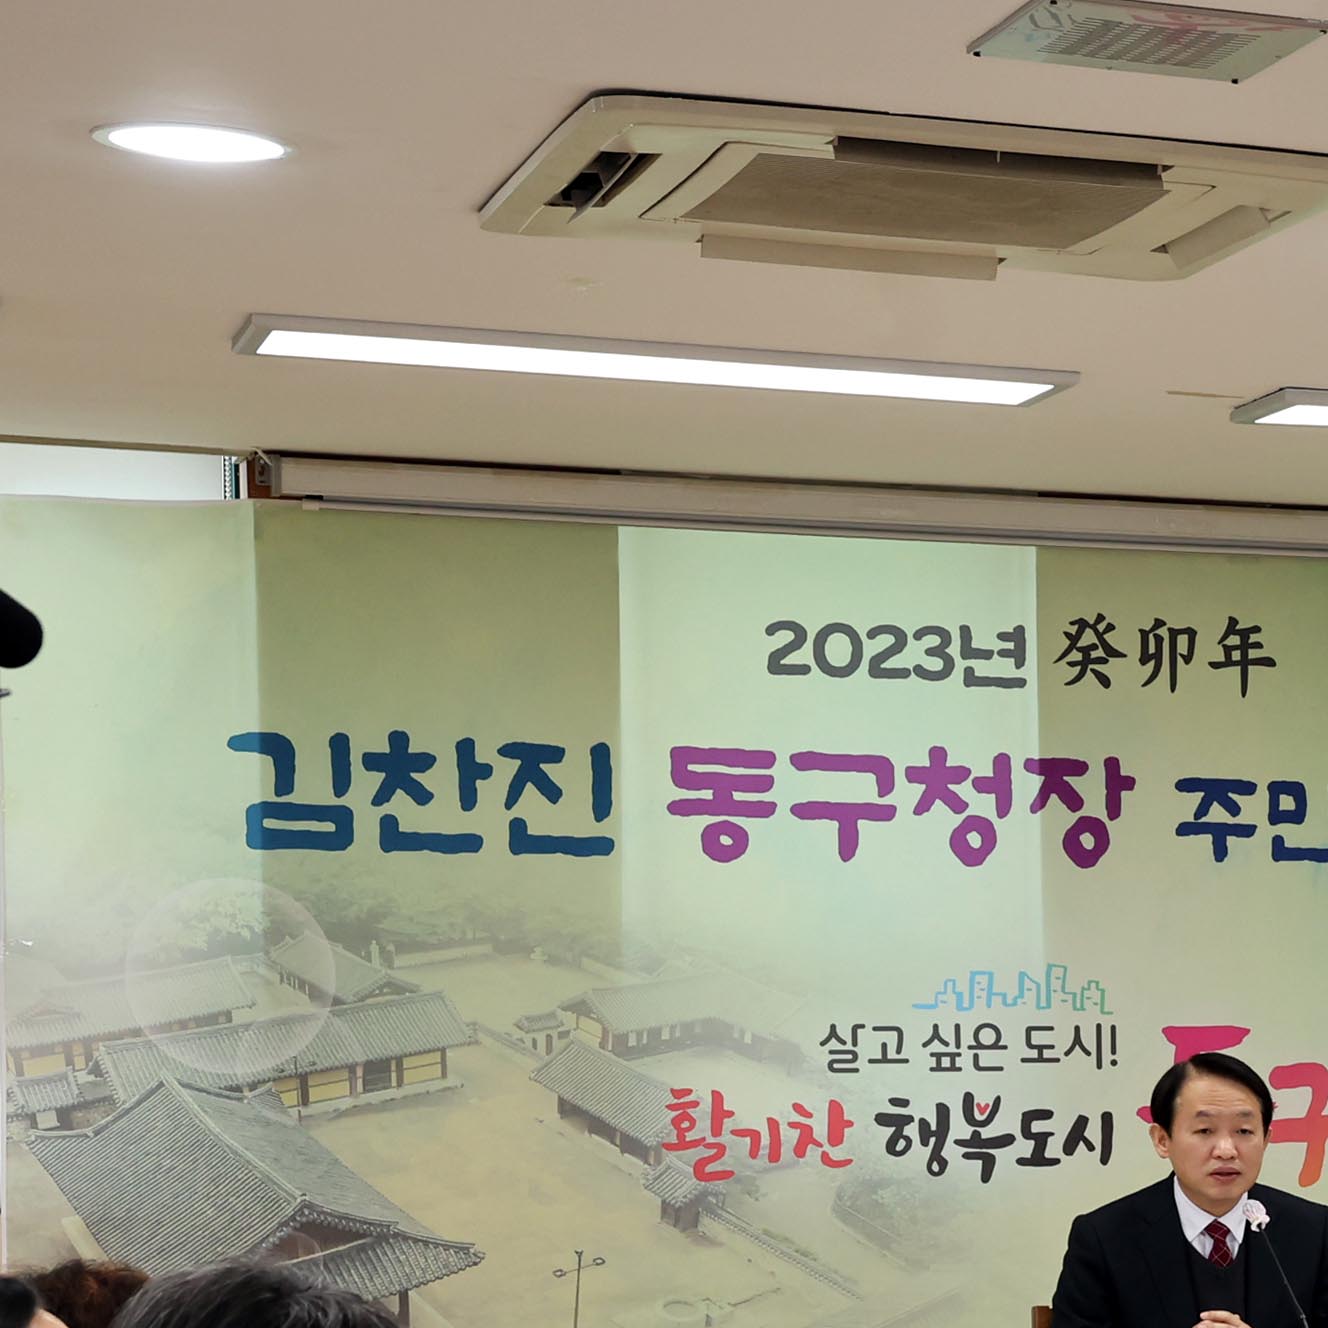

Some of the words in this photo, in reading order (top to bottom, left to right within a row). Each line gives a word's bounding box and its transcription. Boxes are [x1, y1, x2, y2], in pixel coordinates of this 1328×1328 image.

[765, 620, 1027, 688] 2023년
[1053, 613, 1277, 698] 癸卯年
[227, 731, 614, 857] 김찬진
[666, 746, 1136, 868] 동구청장
[819, 1022, 911, 1073] 살고
[921, 1022, 1009, 1073] 싶은
[1020, 1022, 1119, 1070] 도시!
[661, 1087, 854, 1183] 활기찬
[874, 1091, 1115, 1184] 행복도시
